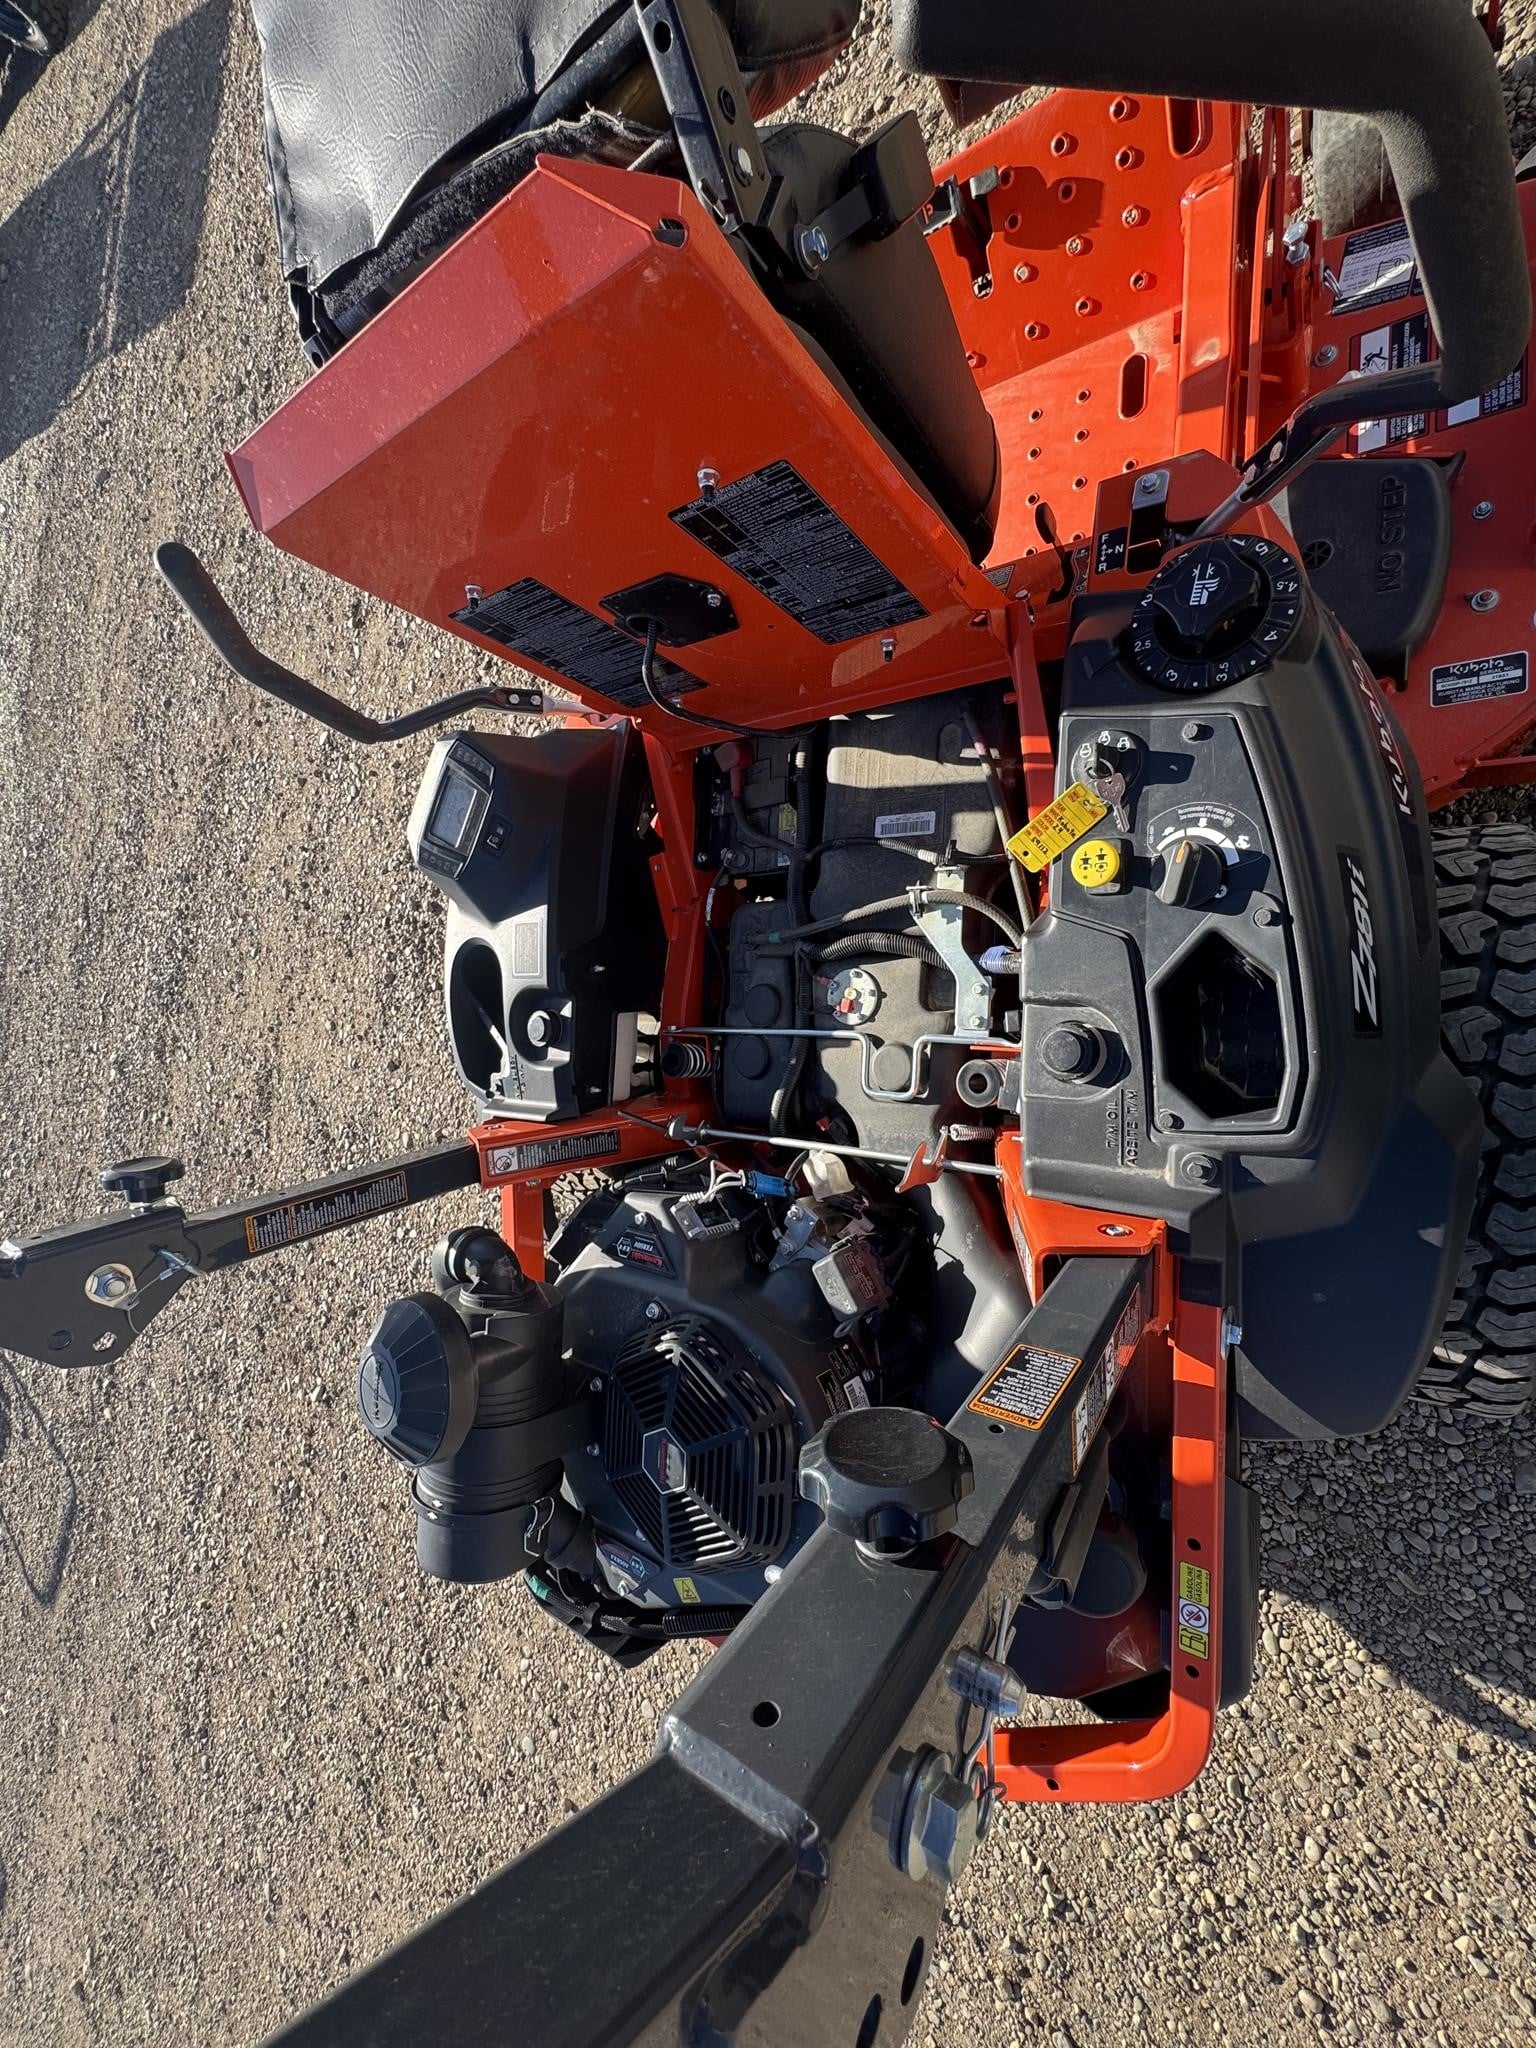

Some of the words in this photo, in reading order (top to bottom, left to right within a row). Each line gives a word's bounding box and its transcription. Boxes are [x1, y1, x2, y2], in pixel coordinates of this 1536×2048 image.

[1381, 476, 1407, 545] STEP
[1101, 533, 1110, 543] F
[1115, 544, 1125, 554] N
[1255, 541, 1269, 556] 5
[1098, 563, 1107, 572] R
[1377, 551, 1404, 594] NO
[1276, 580, 1299, 592] 4.5
[1141, 593, 1153, 607] 2
[1263, 630, 1279, 643] 4
[1134, 640, 1152, 652] 2.5
[1166, 669, 1179, 682] 3
[1216, 661, 1230, 683] 3.5
[1449, 659, 1504, 674] Kubota
[1438, 688, 1464, 697] KUBOTA
[1465, 679, 1520, 692] MANUFACTURING
[1352, 659, 1411, 815] Kubota
[1346, 857, 1378, 1027] Z781i
[1105, 1100, 1119, 1121] OIL
[1126, 1089, 1139, 1115] T/M
[1105, 1124, 1119, 1149] T/M
[1126, 1121, 1139, 1167] ACEITE
[994, 1395, 1036, 1411] COMBUSTIBLE
[998, 1402, 1021, 1412] HABER
[970, 1402, 1026, 1423] ADVERTENCIA
[1186, 1565, 1194, 1600] GASOLINE
[1195, 1569, 1203, 1604] GASOLINA
